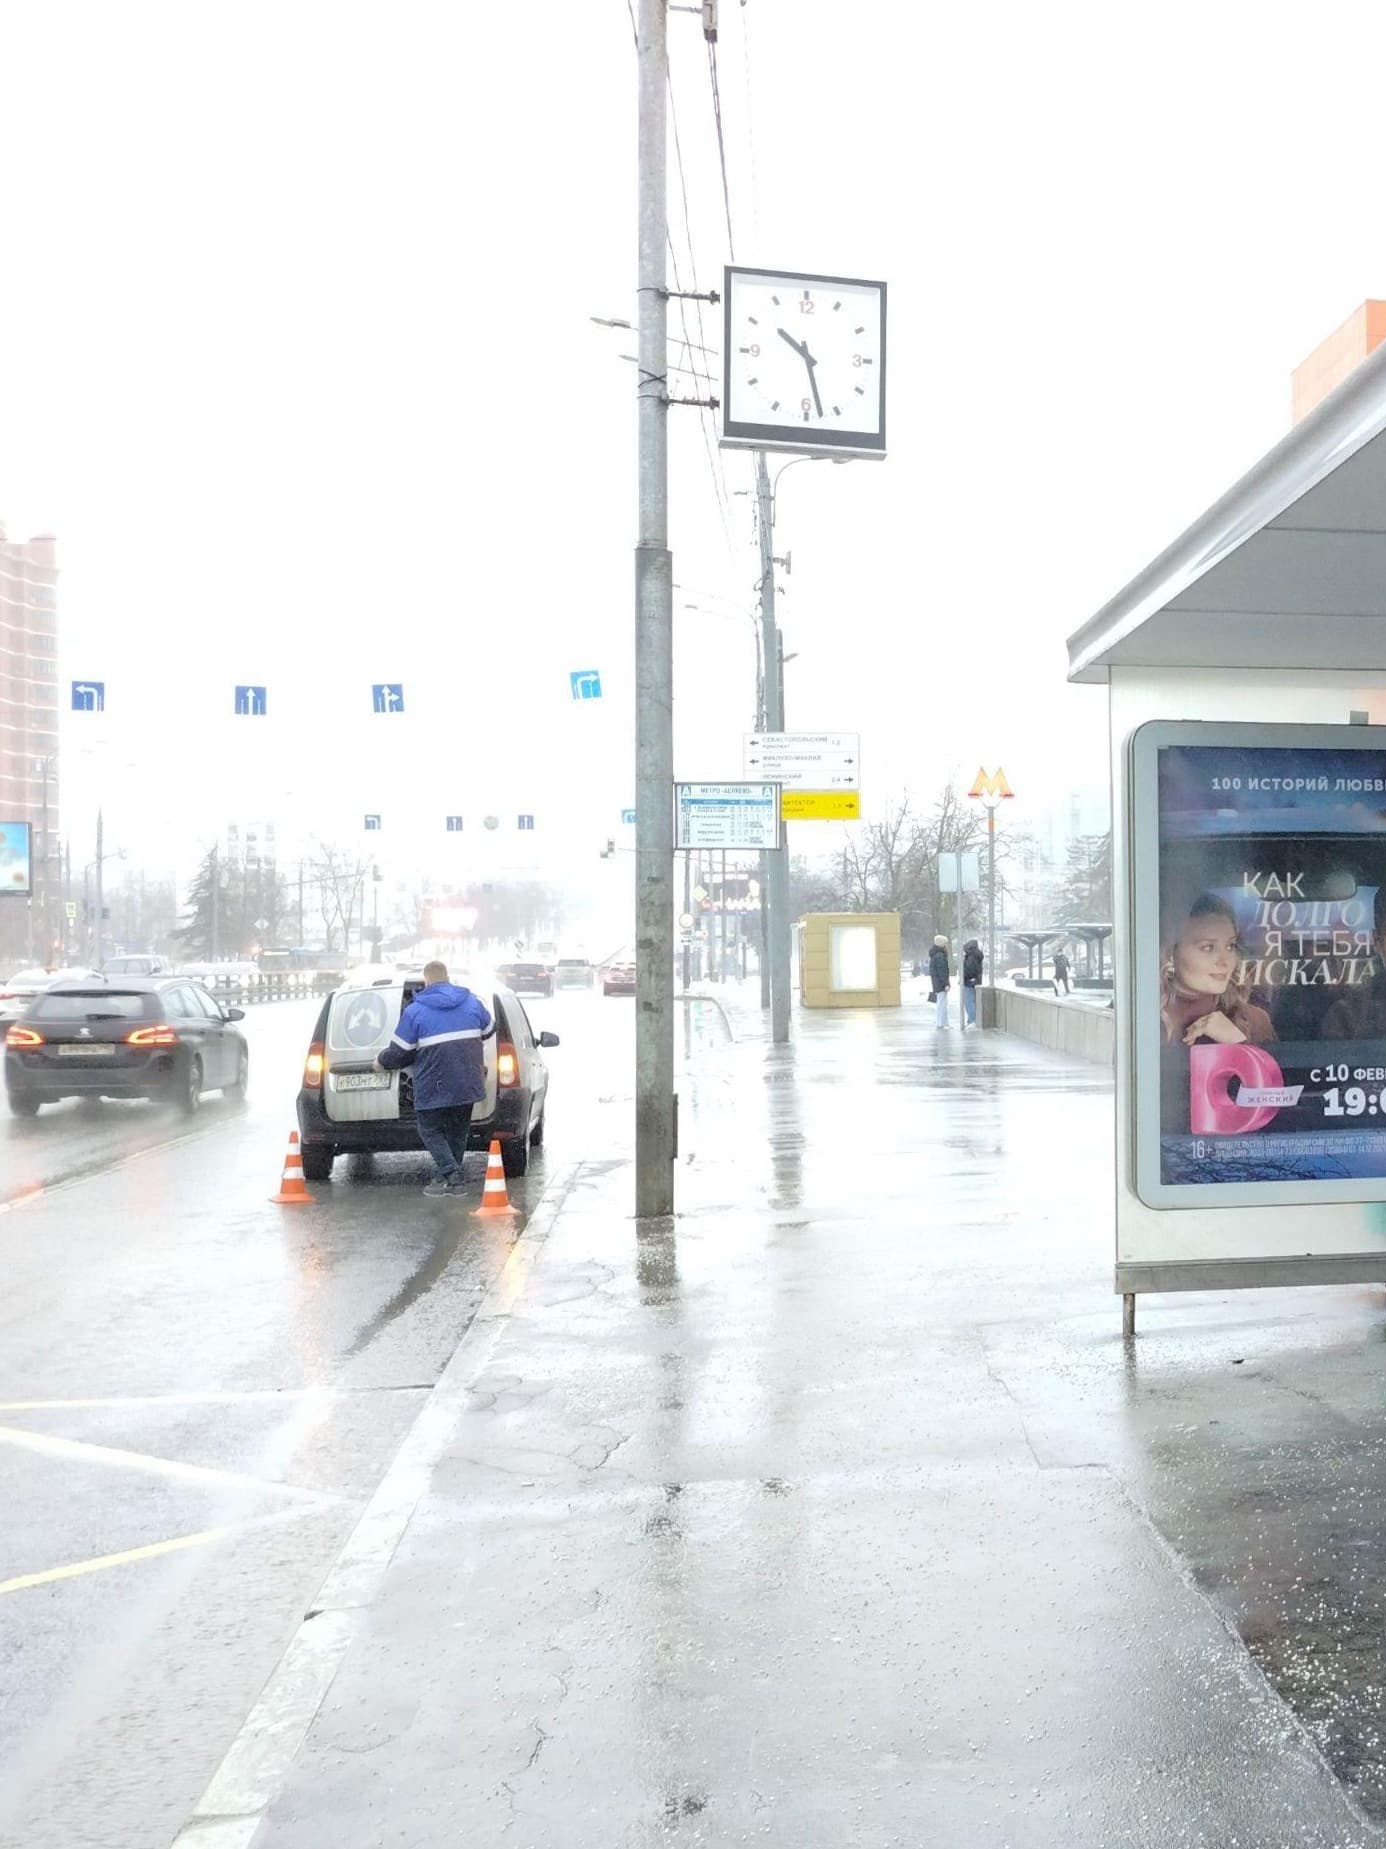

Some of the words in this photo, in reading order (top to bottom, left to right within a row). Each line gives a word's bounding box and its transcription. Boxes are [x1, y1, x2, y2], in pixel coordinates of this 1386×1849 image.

[799, 301, 815, 315] 12
[750, 344, 761, 358] 9
[851, 354, 862, 368] 3
[800, 398, 812, 412] 6
[1211, 778, 1241, 791] 100
[1249, 777, 1329, 791] ИСТОРИЙ
[1243, 871, 1305, 898] КАК
[1250, 900, 1365, 930] ДОЛГО
[1265, 930, 1282, 957] Я
[1291, 930, 1371, 957] ТЕБЯ
[1236, 957, 1378, 986] ИСКАЛА
[1325, 1064, 1349, 1082] 10
[1191, 1140, 1214, 1159] 16+
